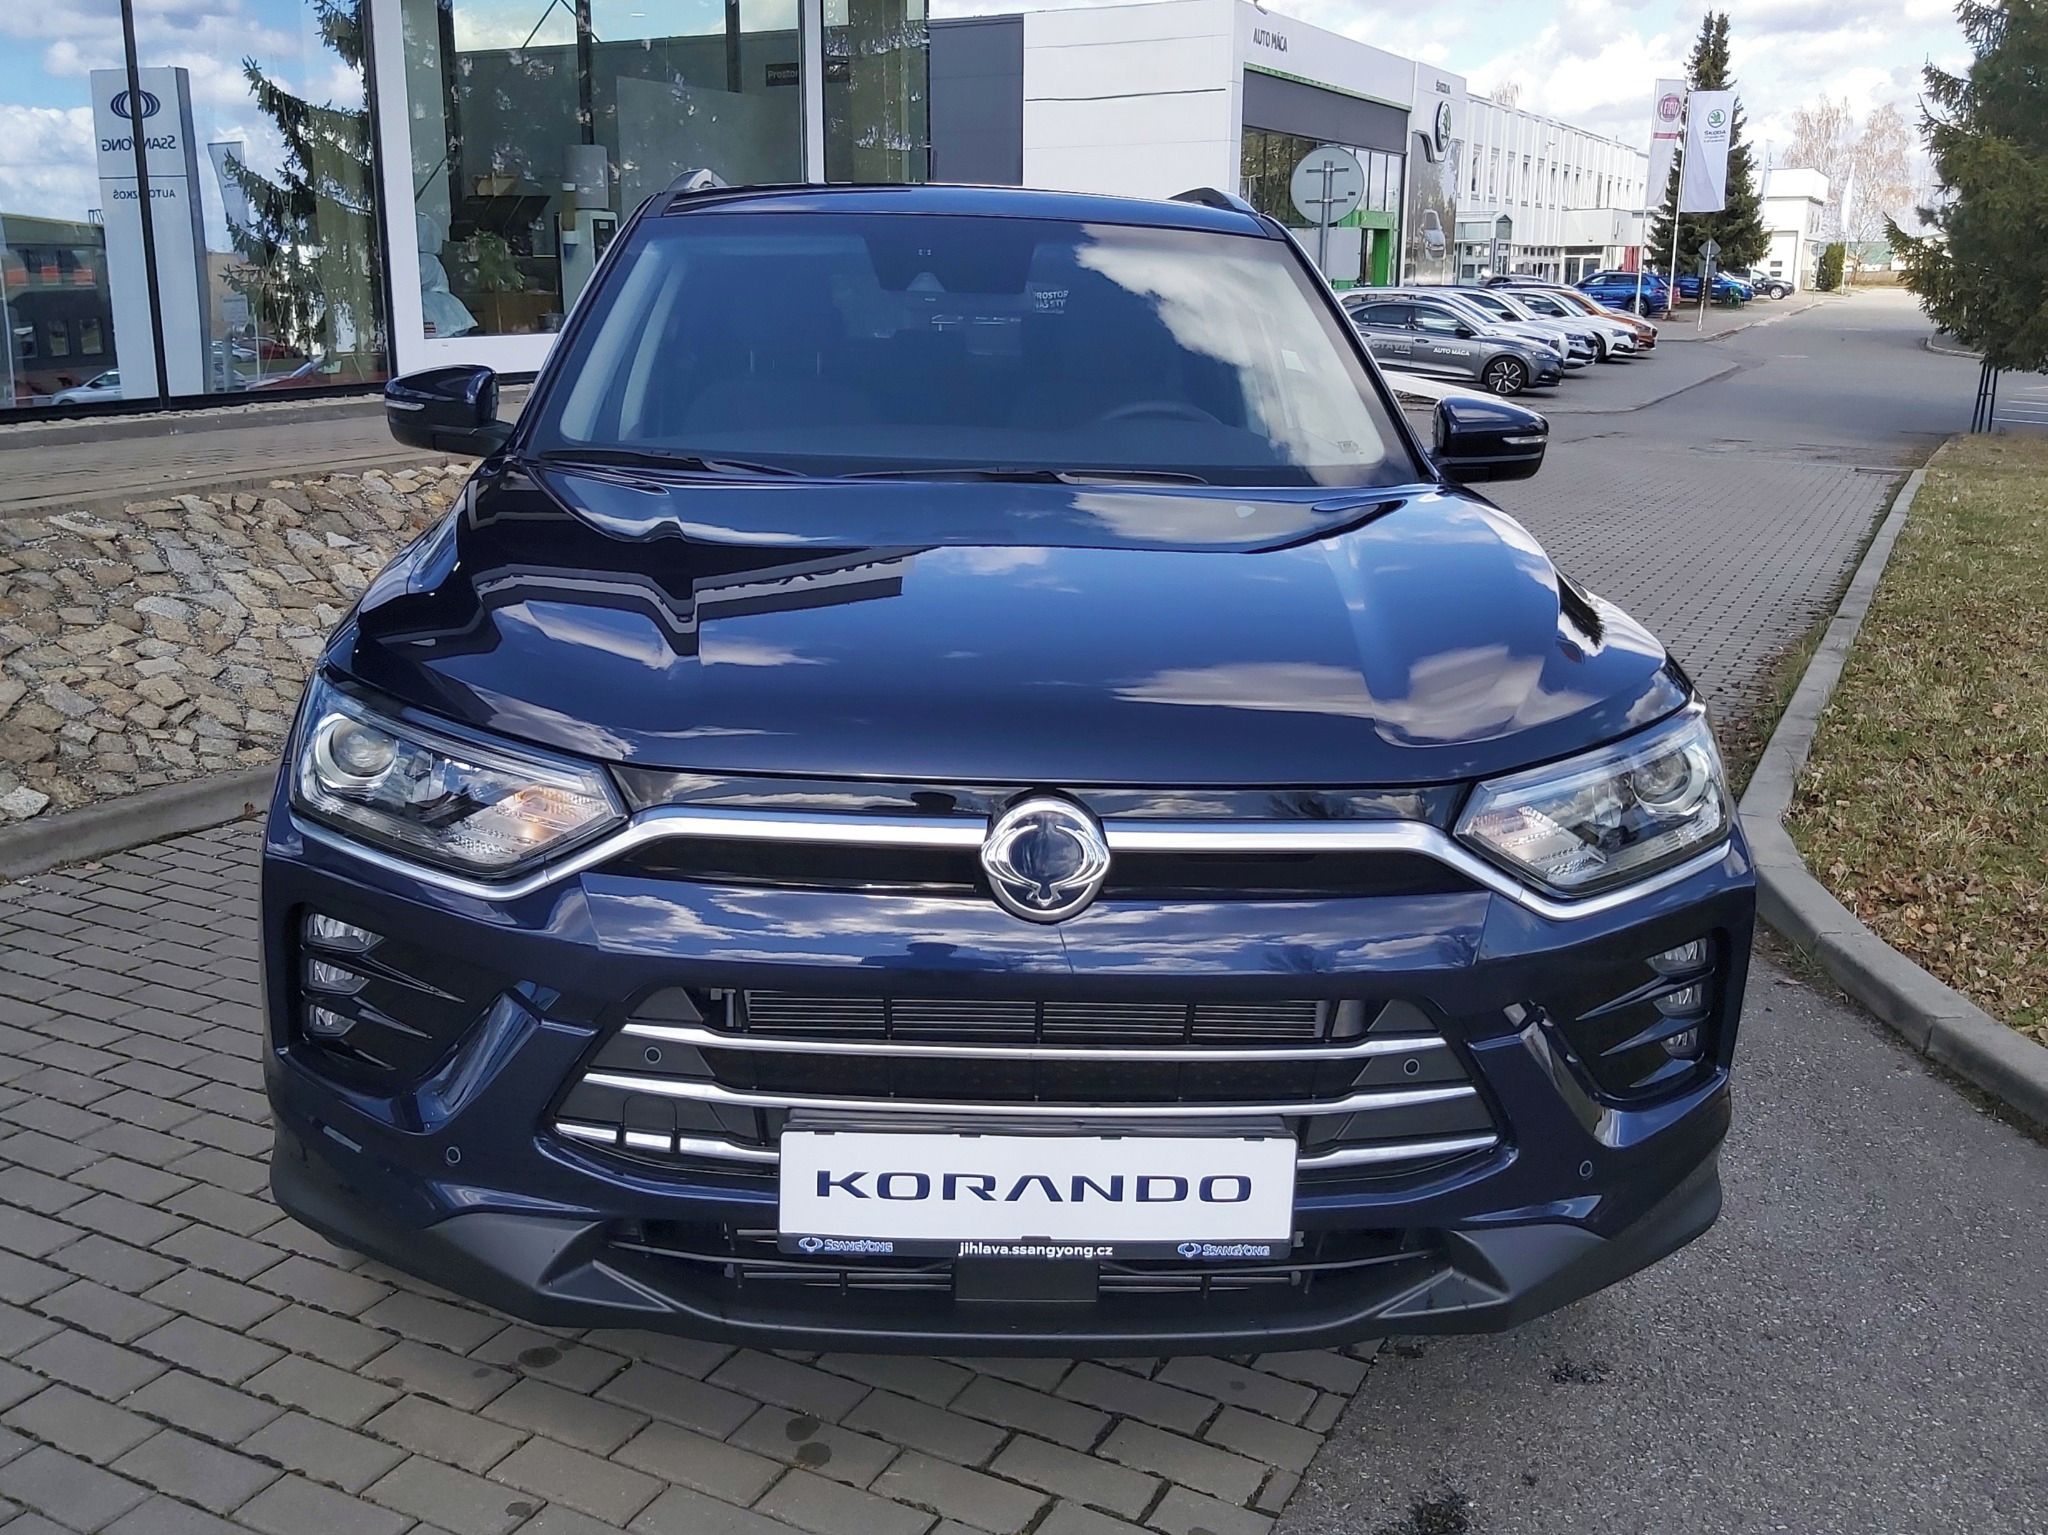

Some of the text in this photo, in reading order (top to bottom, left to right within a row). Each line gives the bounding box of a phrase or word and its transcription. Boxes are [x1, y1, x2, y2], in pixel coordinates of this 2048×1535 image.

[1253, 27, 1270, 47] AUTO
[817, 1170, 1252, 1202] KORANDO
[958, 1242, 1113, 1258] jihlava.ssangyong.cz
